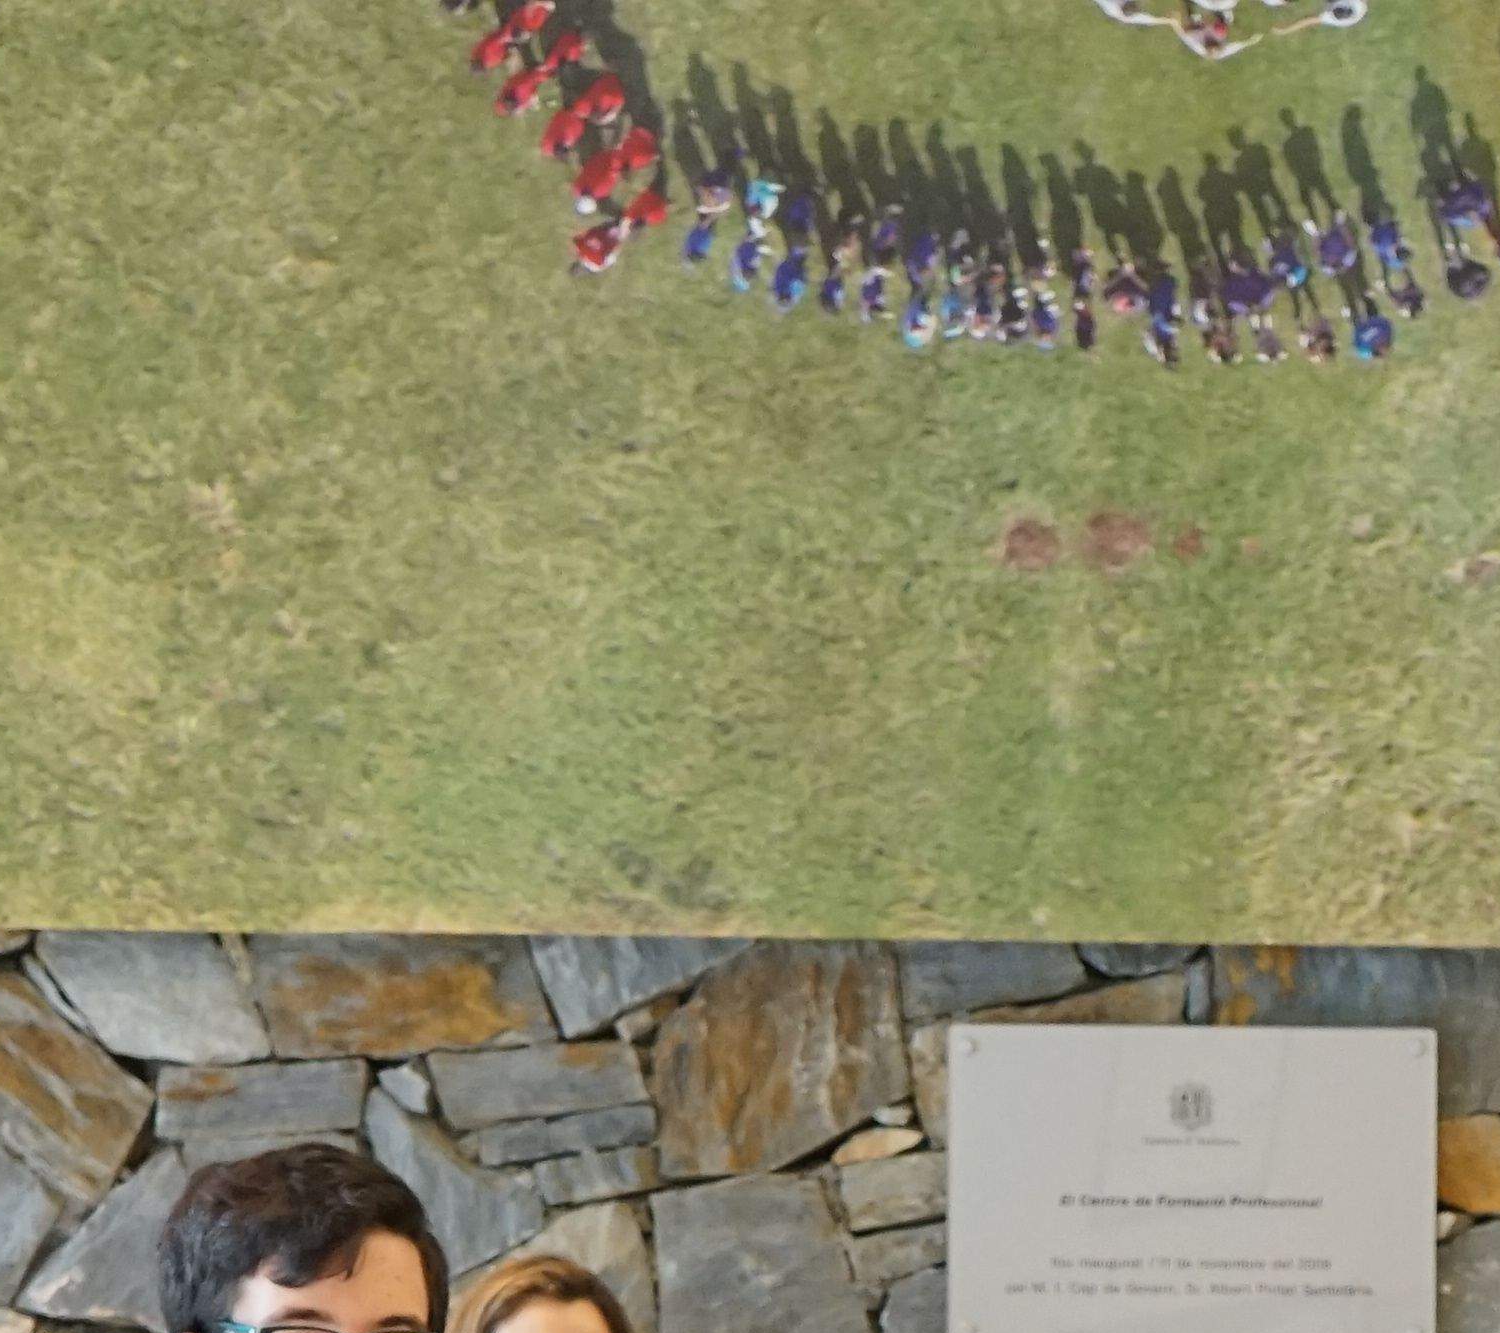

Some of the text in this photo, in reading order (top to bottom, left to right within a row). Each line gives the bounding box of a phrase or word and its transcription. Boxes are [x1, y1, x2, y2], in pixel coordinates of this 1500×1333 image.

[1079, 1194, 1130, 1208] Centre
[1133, 1195, 1153, 1208] de
[1229, 1195, 1324, 1209] Professional
